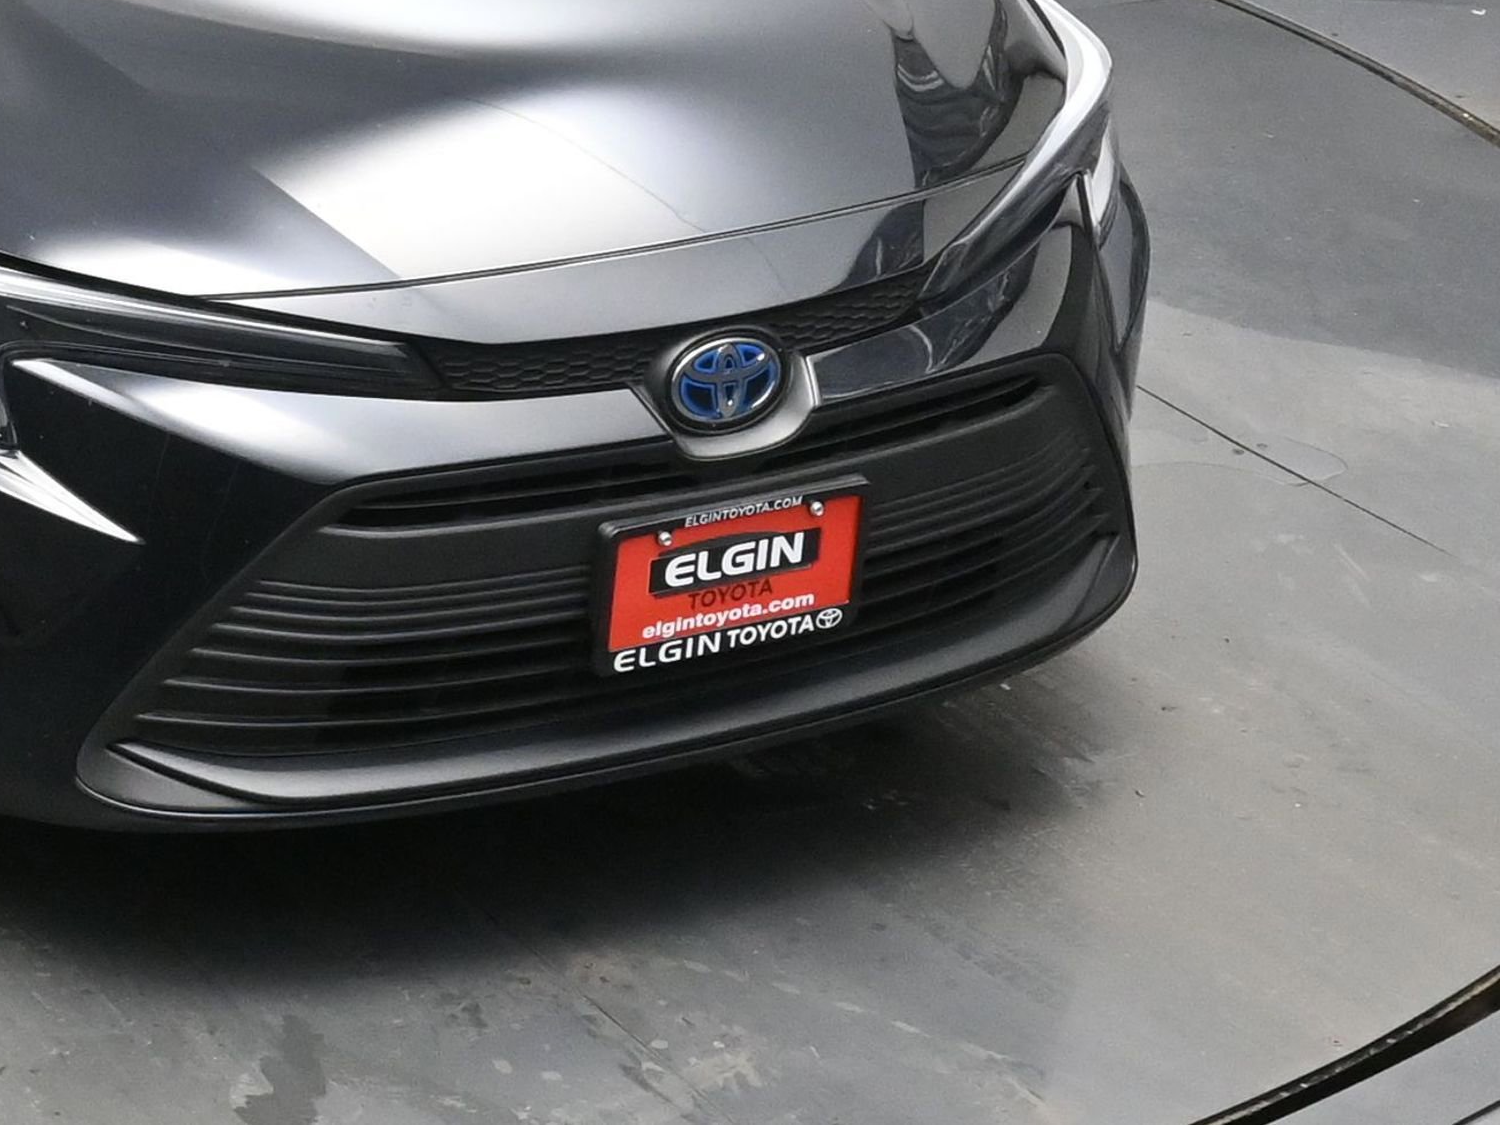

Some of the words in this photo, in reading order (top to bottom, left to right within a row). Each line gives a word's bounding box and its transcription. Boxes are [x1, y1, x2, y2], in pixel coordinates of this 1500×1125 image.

[684, 496, 803, 528] ELGINTOYOTA.COM
[665, 532, 804, 587] ELGIN
[642, 594, 815, 639] elgintoyota.com
[688, 579, 773, 611] TOYOTA
[613, 632, 721, 673] ELGIN
[727, 615, 815, 648] TOYOTA
